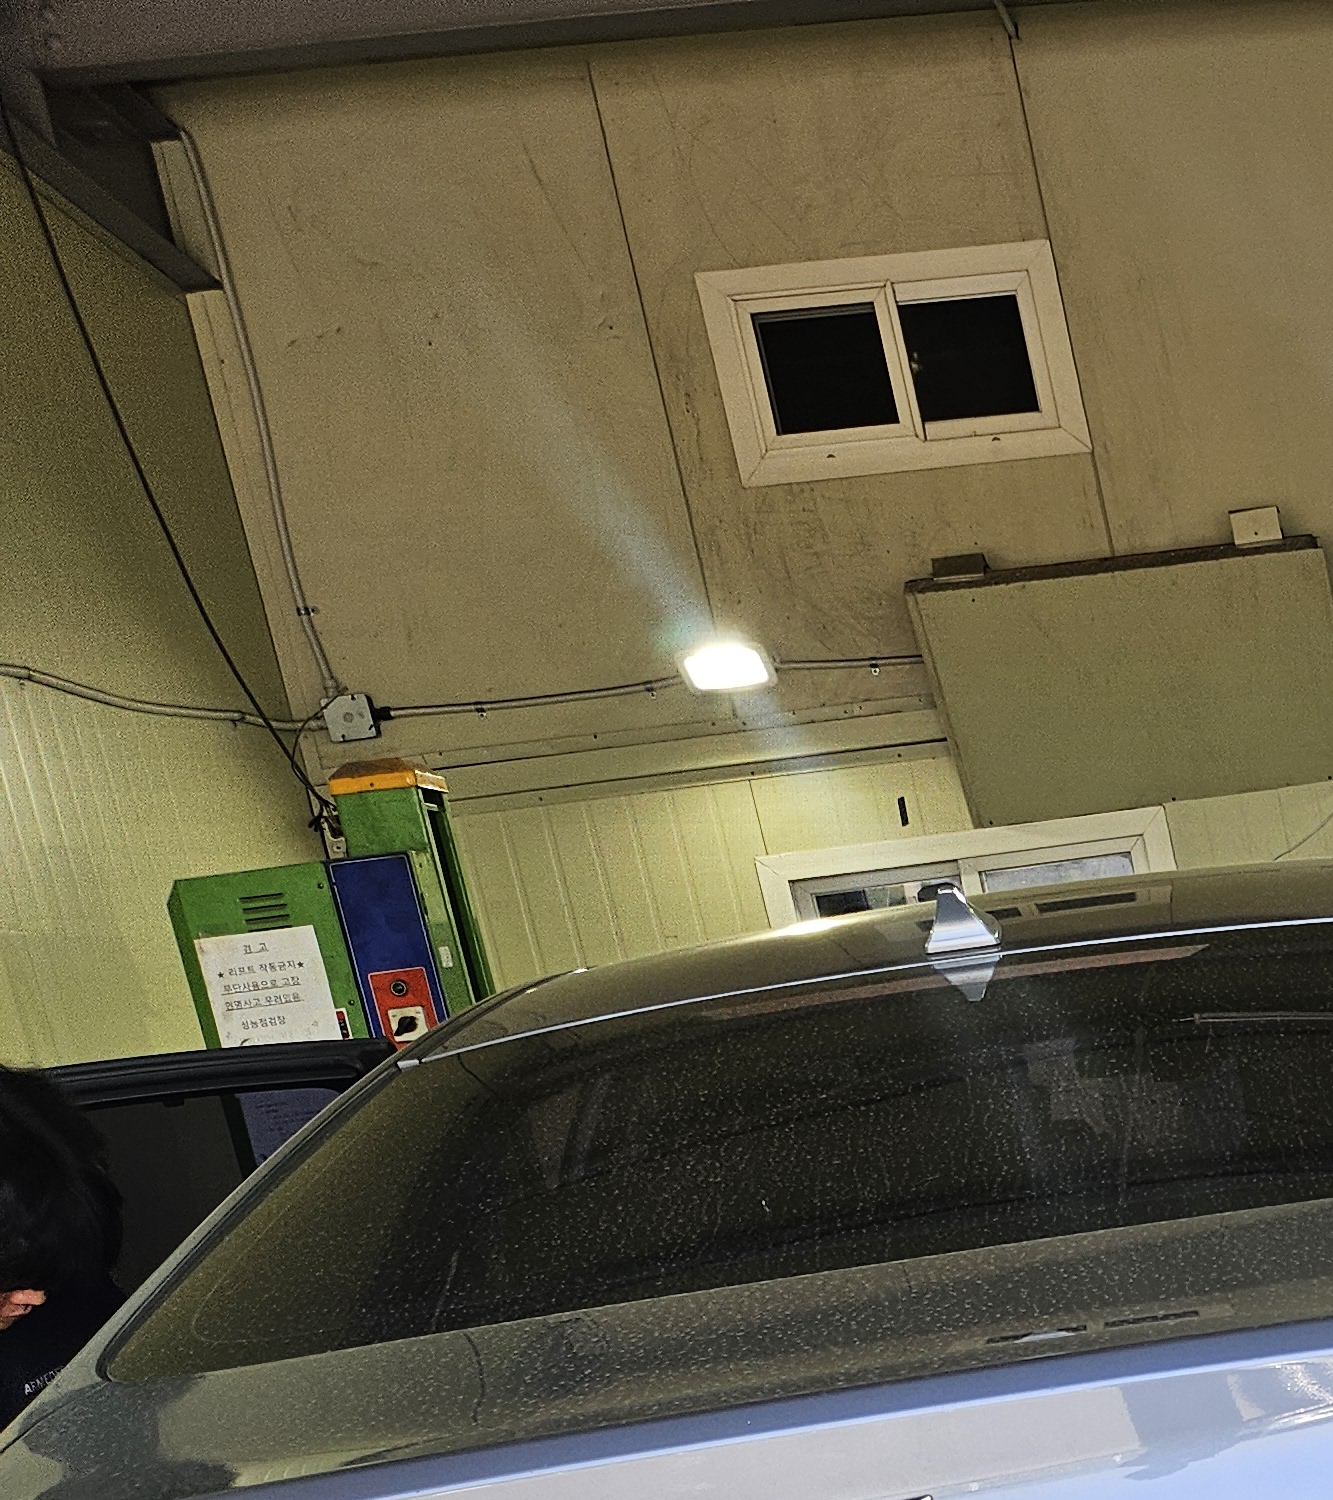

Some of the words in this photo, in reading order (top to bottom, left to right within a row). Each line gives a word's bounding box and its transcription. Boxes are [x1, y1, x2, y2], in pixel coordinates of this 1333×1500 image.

[228, 965, 256, 975] 리프트
[259, 960, 296, 972] 작동금지
[241, 1015, 286, 1029] 성능점검장
